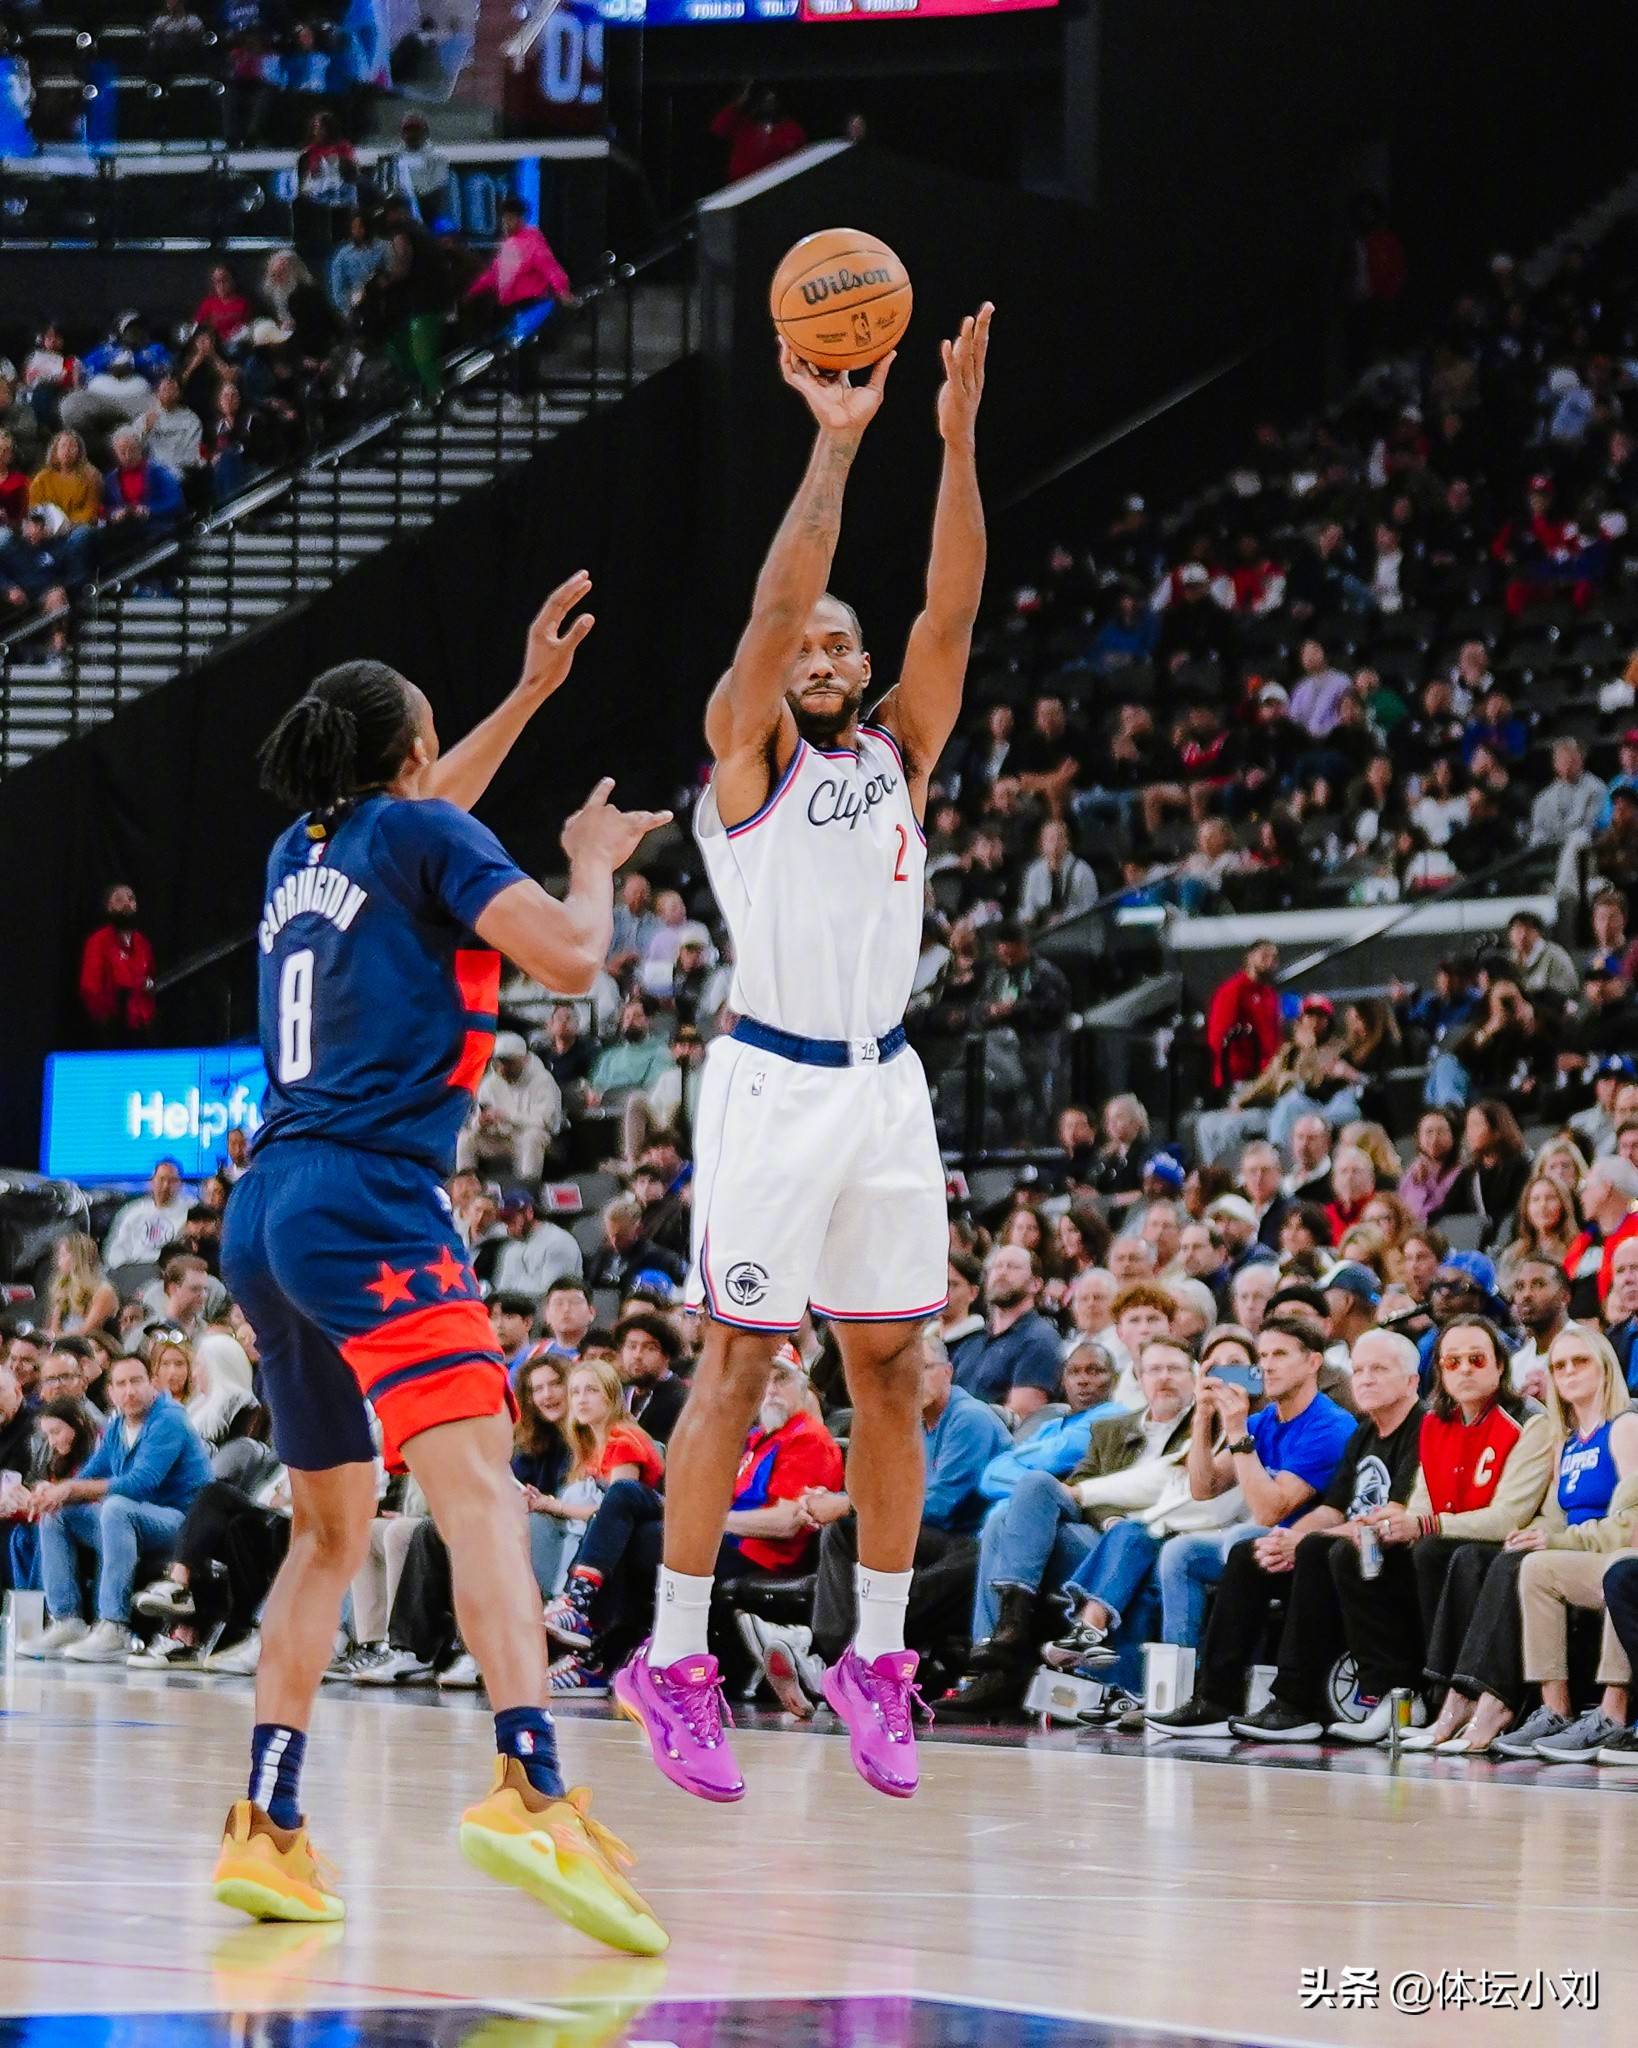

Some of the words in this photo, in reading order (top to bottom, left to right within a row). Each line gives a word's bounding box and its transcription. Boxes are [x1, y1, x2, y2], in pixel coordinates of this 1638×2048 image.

[801, 268, 892, 305] Wilson
[894, 823, 909, 881] 2
[258, 865, 368, 955] CARRINGTON
[278, 948, 315, 1085] 8
[1473, 1446, 1496, 1487] C
